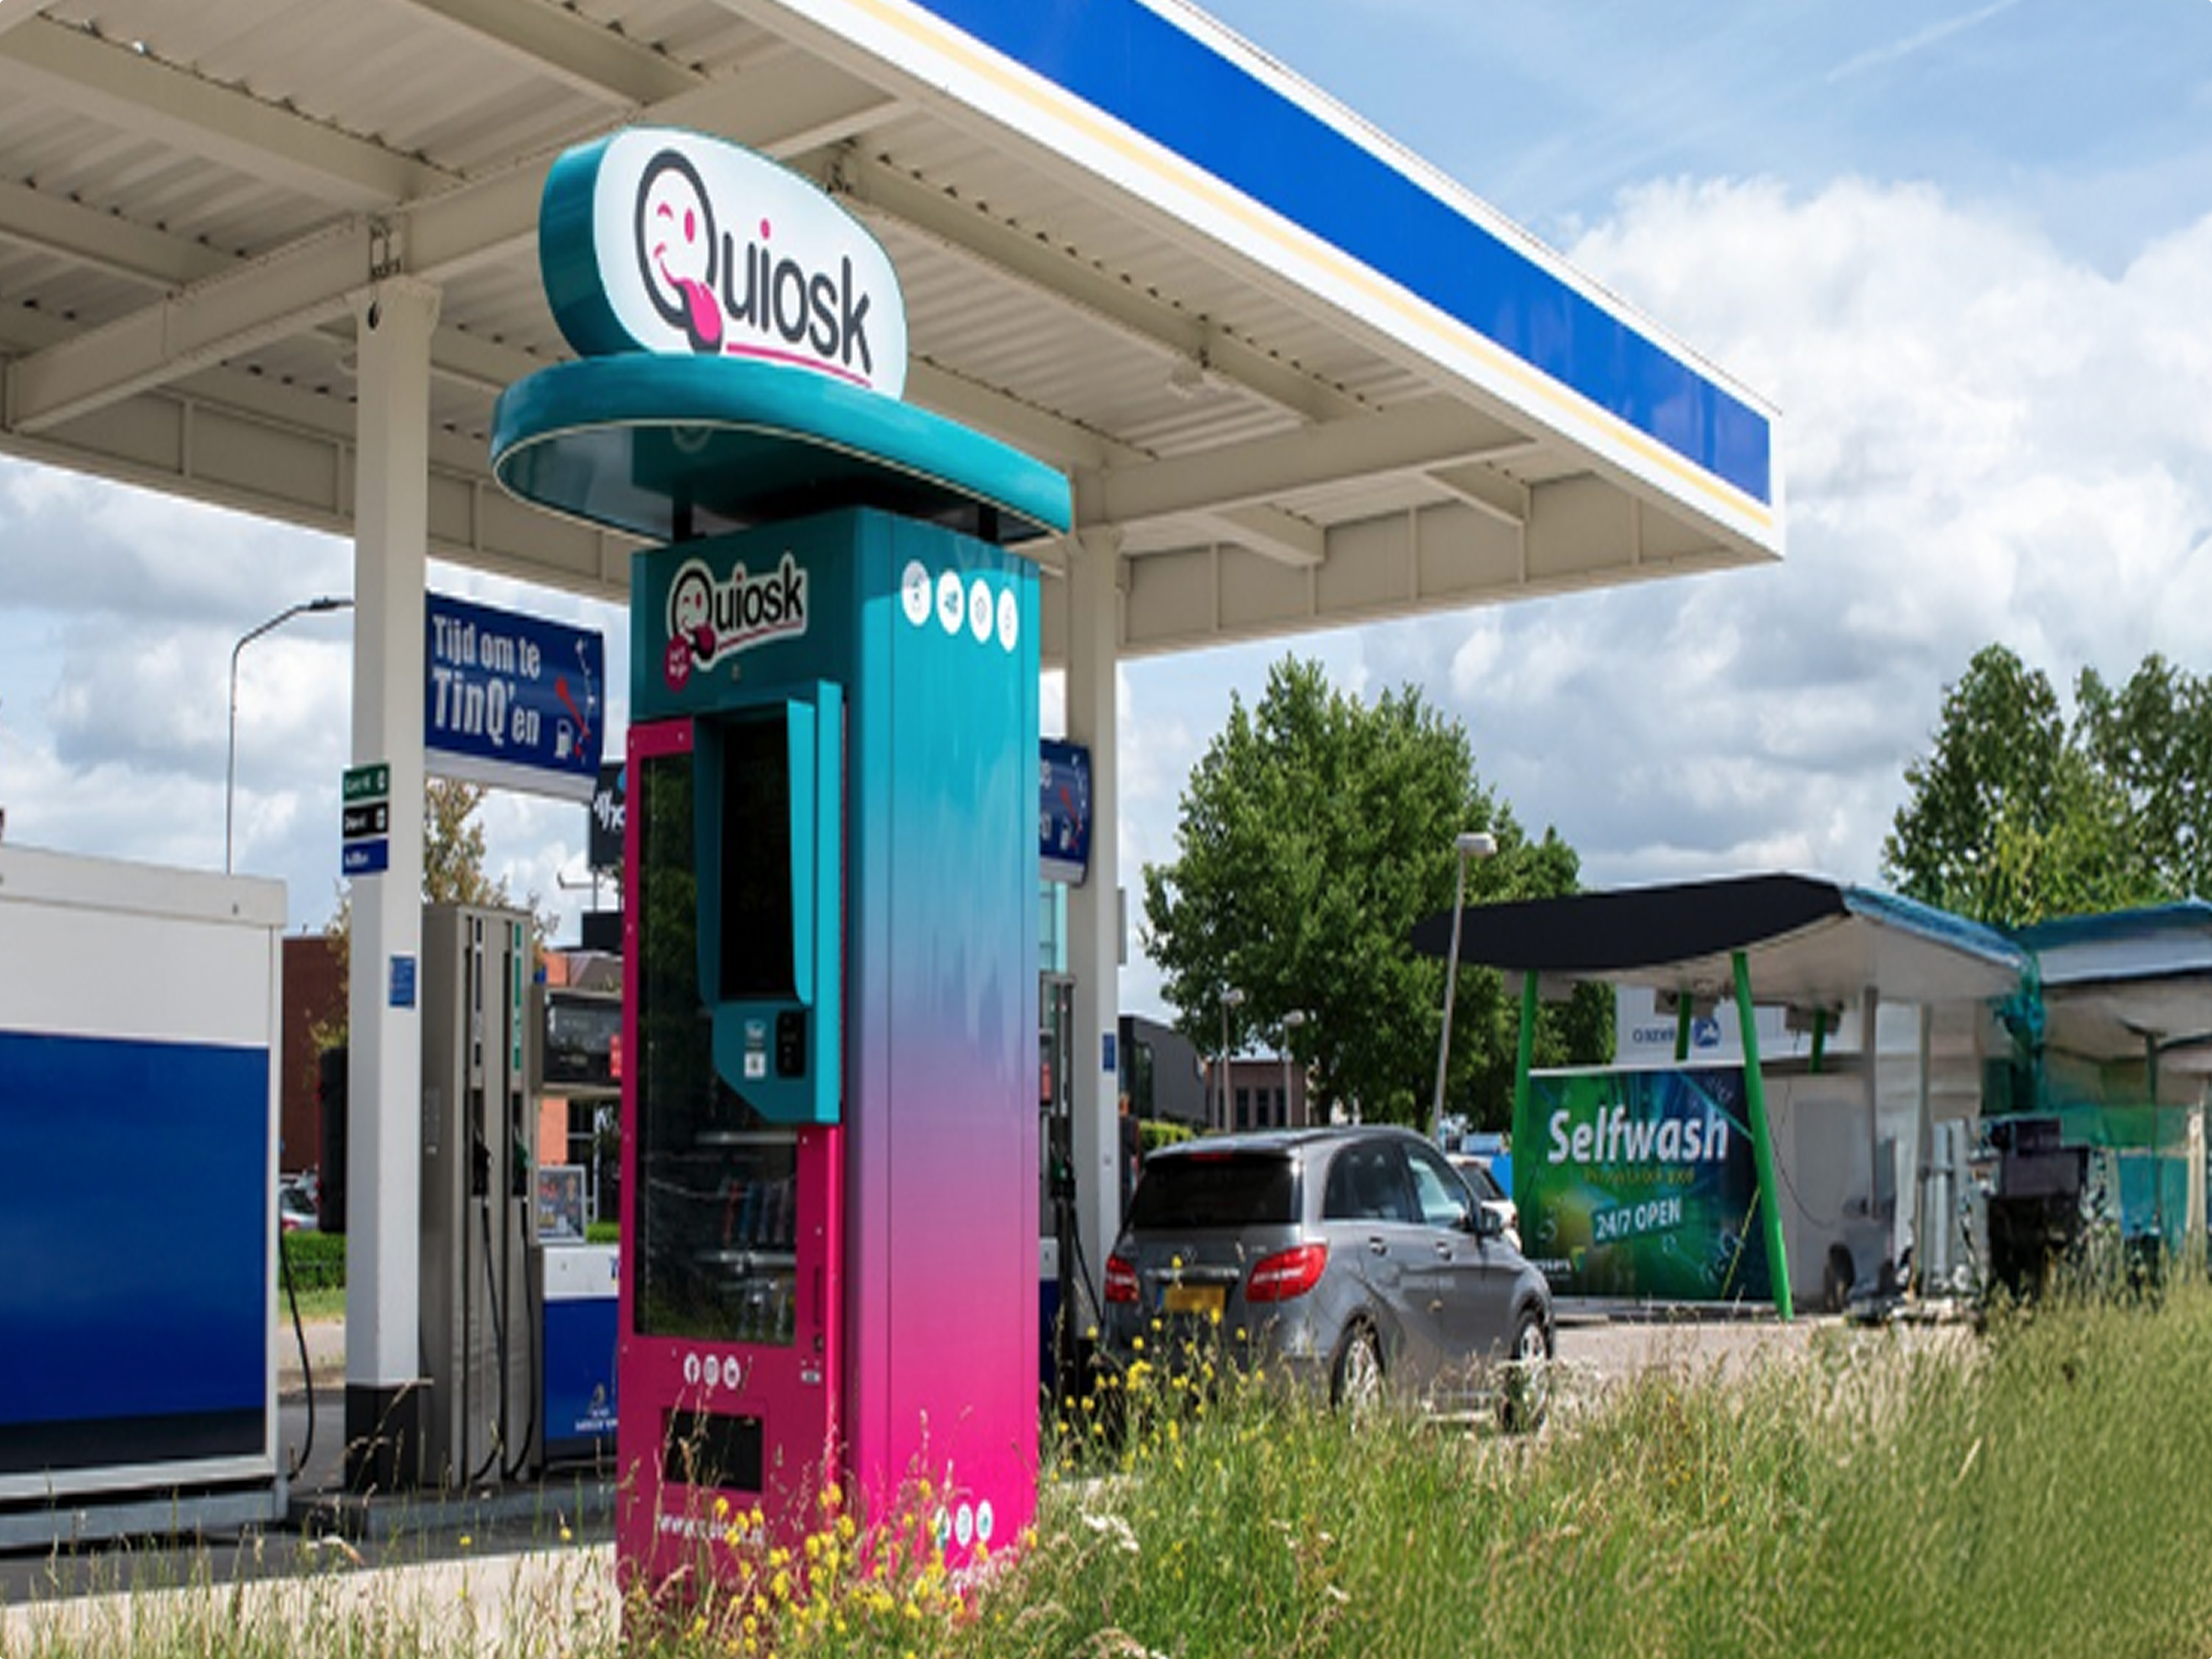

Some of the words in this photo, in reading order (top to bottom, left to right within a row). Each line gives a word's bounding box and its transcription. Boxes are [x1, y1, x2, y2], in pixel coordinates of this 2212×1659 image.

[634, 148, 872, 375] Quiosk
[670, 560, 804, 663] Quiosk
[432, 613, 476, 665] Tijd
[479, 632, 515, 673] om
[518, 635, 541, 679] te
[1548, 1105, 1730, 1163] Selfwash
[1595, 1208, 1631, 1240] 24/7
[1634, 1196, 1682, 1232] OPEN
